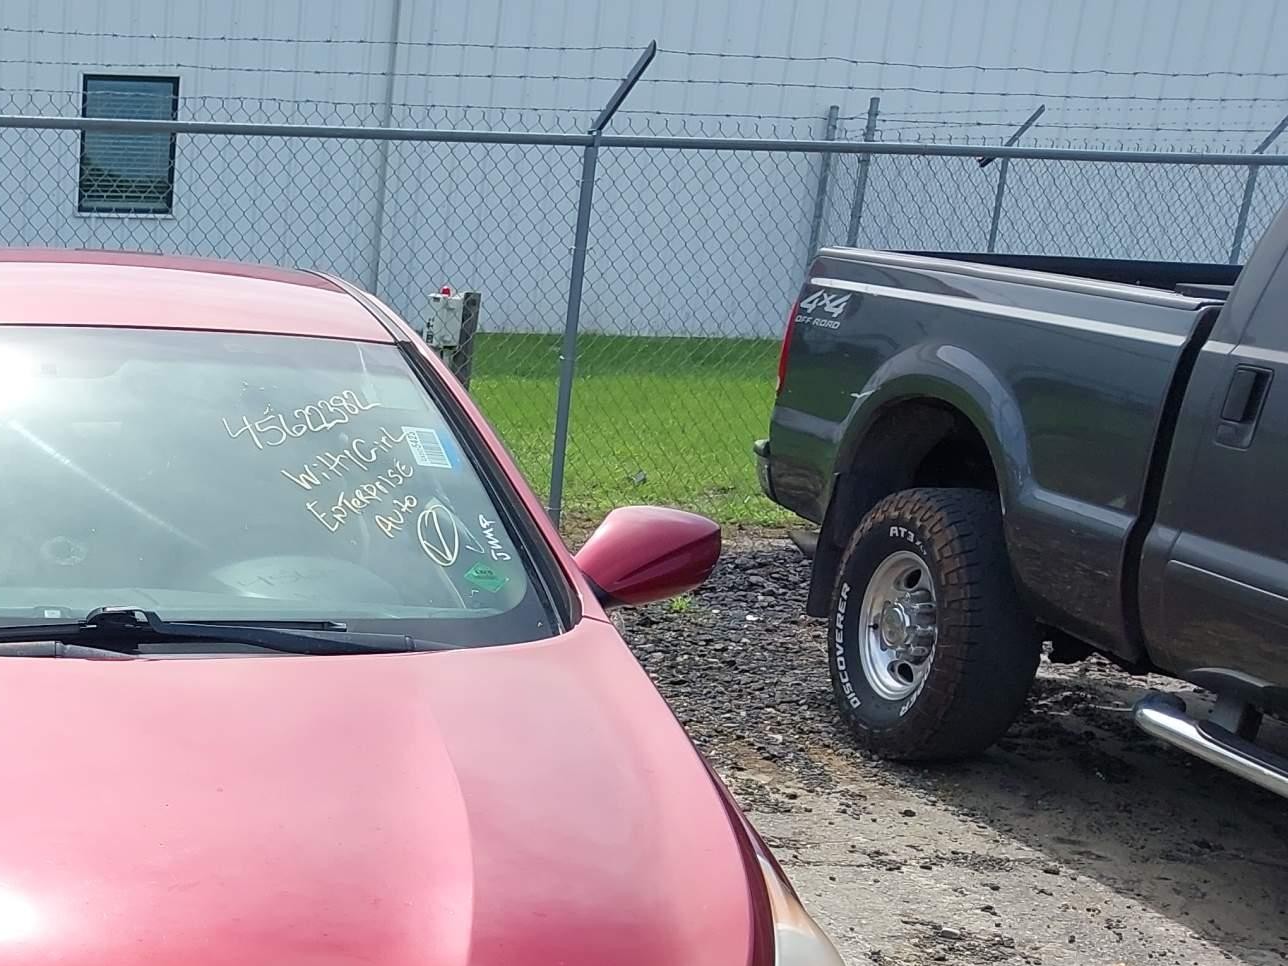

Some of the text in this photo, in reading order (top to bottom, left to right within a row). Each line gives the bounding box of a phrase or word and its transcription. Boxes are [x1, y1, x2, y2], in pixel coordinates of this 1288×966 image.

[795, 314, 841, 329] OFF ROAD
[222, 389, 383, 449] 45622382
[835, 582, 861, 708] DISCOVERER
